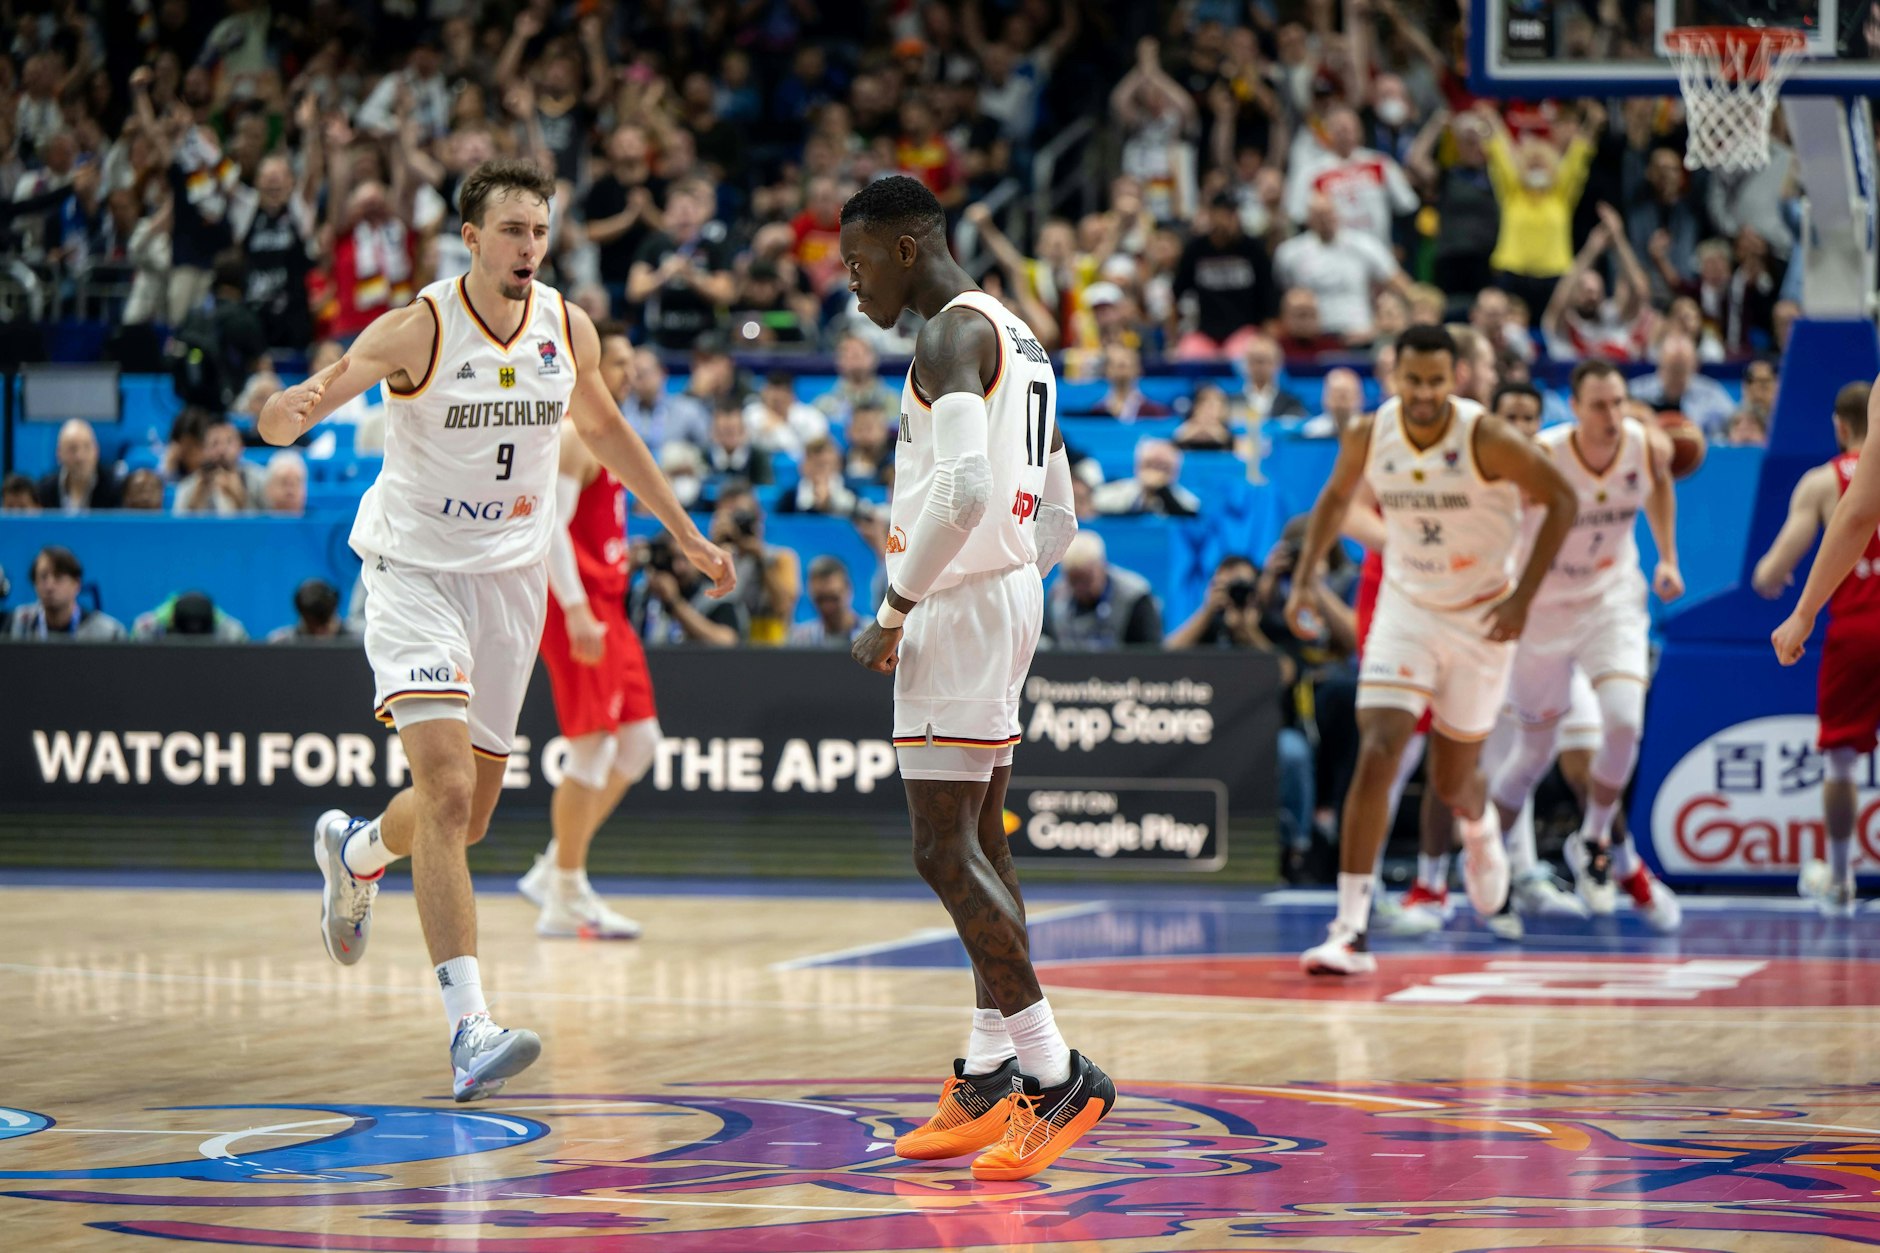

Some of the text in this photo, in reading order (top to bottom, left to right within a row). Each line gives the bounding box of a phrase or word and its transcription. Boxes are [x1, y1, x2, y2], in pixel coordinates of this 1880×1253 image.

[444, 400, 563, 429] DEUTSCHLAND
[495, 443, 515, 481] 9
[440, 497, 504, 521] ING
[409, 666, 450, 682] ING
[1026, 676, 1214, 705] Download on the
[1027, 699, 1214, 752] App Store
[33, 730, 247, 785] WATCH
[257, 732, 377, 787] FOR
[386, 734, 531, 789] FE
[652, 738, 764, 792] THE
[772, 738, 897, 793] APP
[1028, 790, 1066, 814] GET
[1085, 791, 1118, 815] ON
[1027, 812, 1209, 858] Google Play
[1673, 795, 1880, 868] Gan
